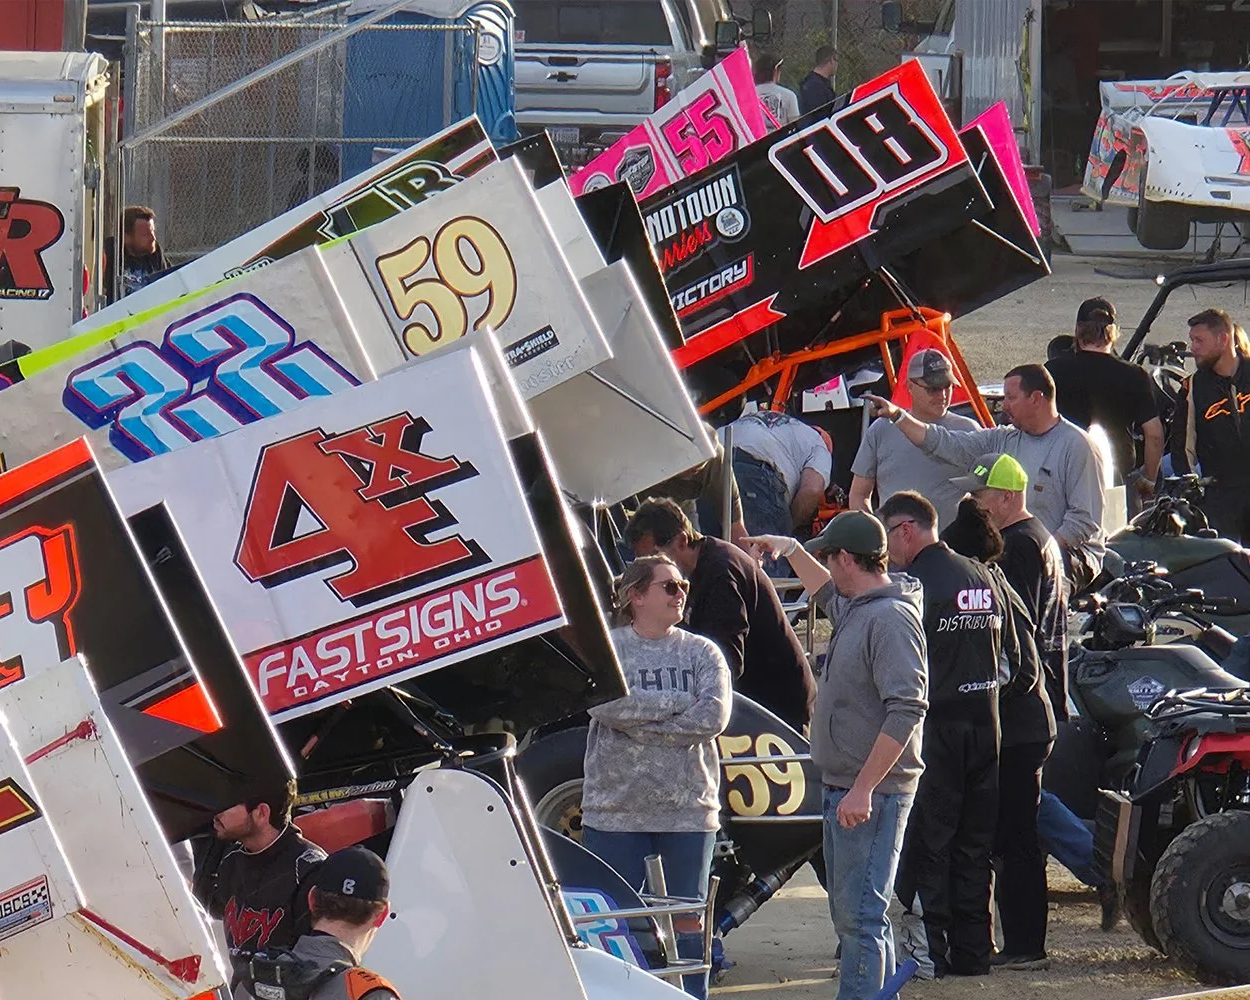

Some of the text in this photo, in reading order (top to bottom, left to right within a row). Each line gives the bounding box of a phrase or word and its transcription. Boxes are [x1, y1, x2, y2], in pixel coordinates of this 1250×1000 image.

[659, 88, 739, 178] 55
[768, 83, 948, 224] 08
[37, 288, 50, 298] 17
[376, 216, 517, 356] 59
[62, 292, 362, 463] 22
[259, 571, 520, 696] FASTSIGNS
[434, 618, 502, 650] OHIO
[956, 588, 992, 610] CMS
[630, 667, 696, 693] HIO
[717, 733, 806, 817] 59
